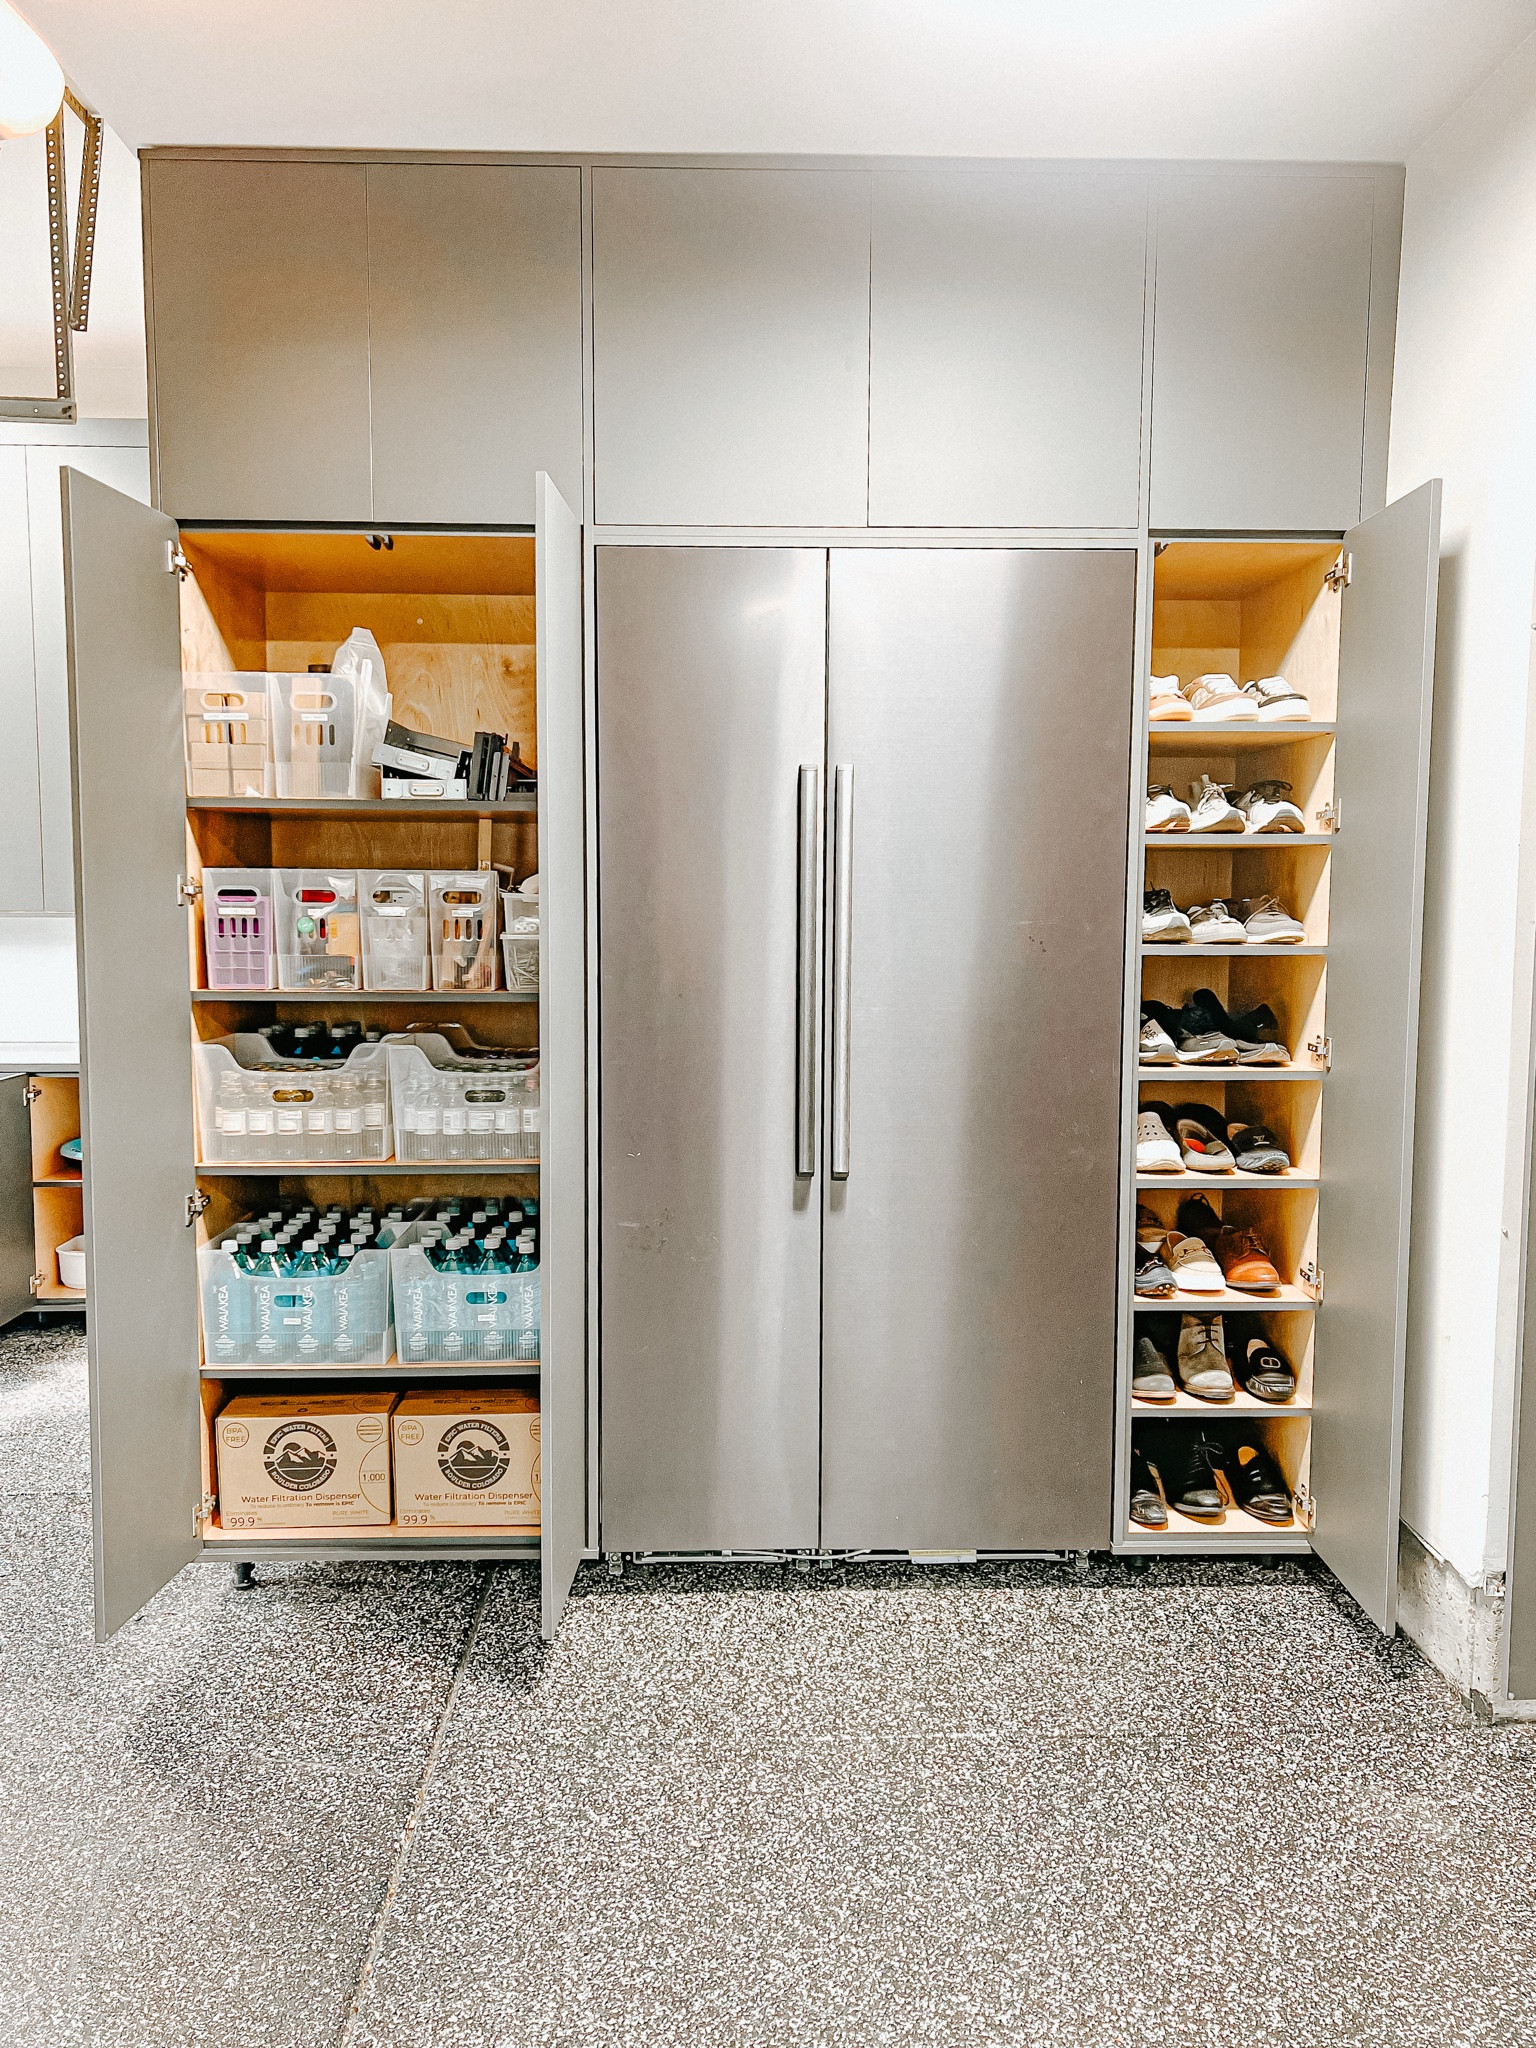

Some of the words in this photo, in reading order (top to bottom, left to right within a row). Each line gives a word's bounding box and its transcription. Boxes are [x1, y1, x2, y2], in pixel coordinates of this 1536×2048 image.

[226, 1427, 243, 1435] BPA
[282, 1423, 306, 1433] WATER
[306, 1424, 330, 1443] FILTERS
[444, 1428, 458, 1443] EPIC
[456, 1422, 480, 1431] WATER
[480, 1423, 503, 1442] FILTERS
[271, 1470, 298, 1490] BOULDER
[298, 1469, 331, 1490] COLORADO
[444, 1469, 471, 1489] BOULDER
[471, 1468, 504, 1489] COLORADO
[241, 1495, 270, 1503] Water
[271, 1493, 313, 1503] Filtration
[315, 1493, 361, 1502] Dispenser
[414, 1493, 442, 1501] Water
[444, 1492, 486, 1501] Filtration
[487, 1492, 533, 1501] Dispenser
